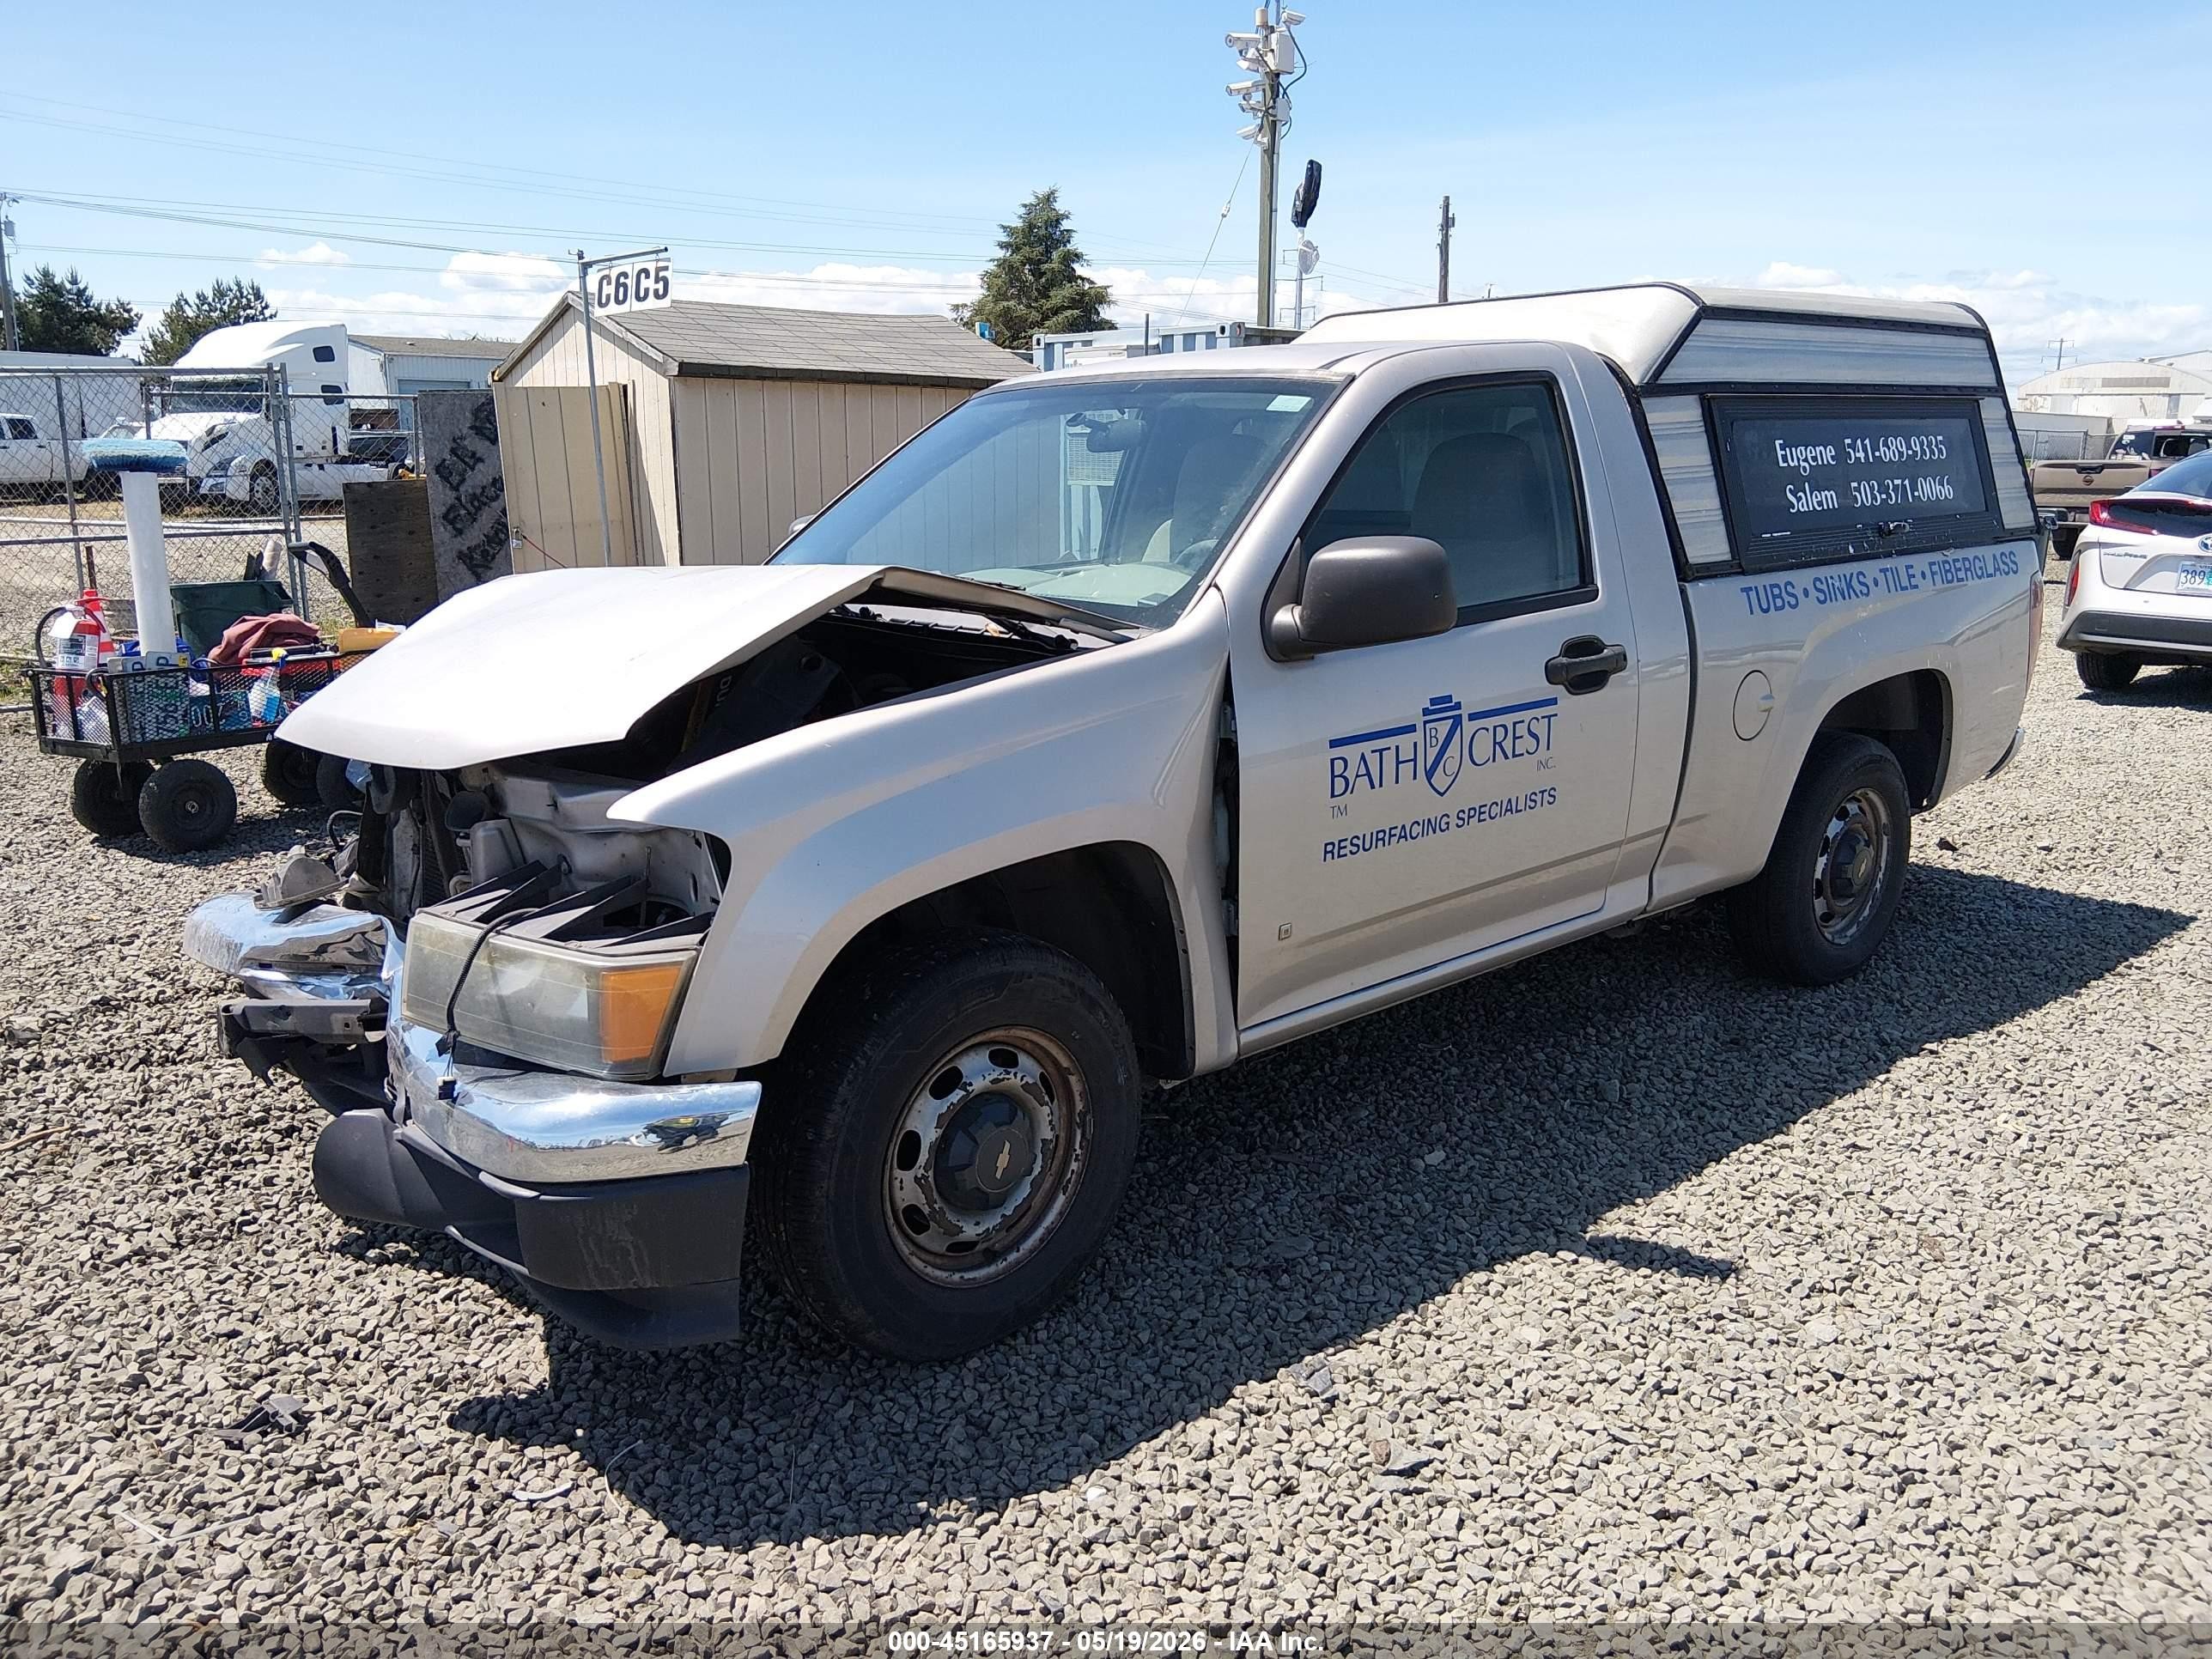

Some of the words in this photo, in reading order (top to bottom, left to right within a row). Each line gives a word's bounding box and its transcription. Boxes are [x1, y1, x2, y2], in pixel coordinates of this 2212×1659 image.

[1775, 440, 1836, 476] Eugene
[1844, 435, 1947, 464] 541-689-9335
[1786, 482, 1838, 513] Salem
[1850, 475, 1954, 507] 503-371-0066
[1741, 580, 1799, 615] TUBS
[1813, 570, 1870, 605] SINKS
[1879, 563, 1919, 593] TILE
[1928, 550, 2019, 586] FIBERGLASS
[1330, 742, 1418, 799] BATH
[1468, 713, 1559, 767] CREST
[1429, 726, 1439, 749] B
[1443, 756, 1455, 777] C
[1323, 812, 1451, 862] RESURFACING
[1455, 786, 1558, 829] SPECIALISTS
[1329, 803, 1348, 819] TM
